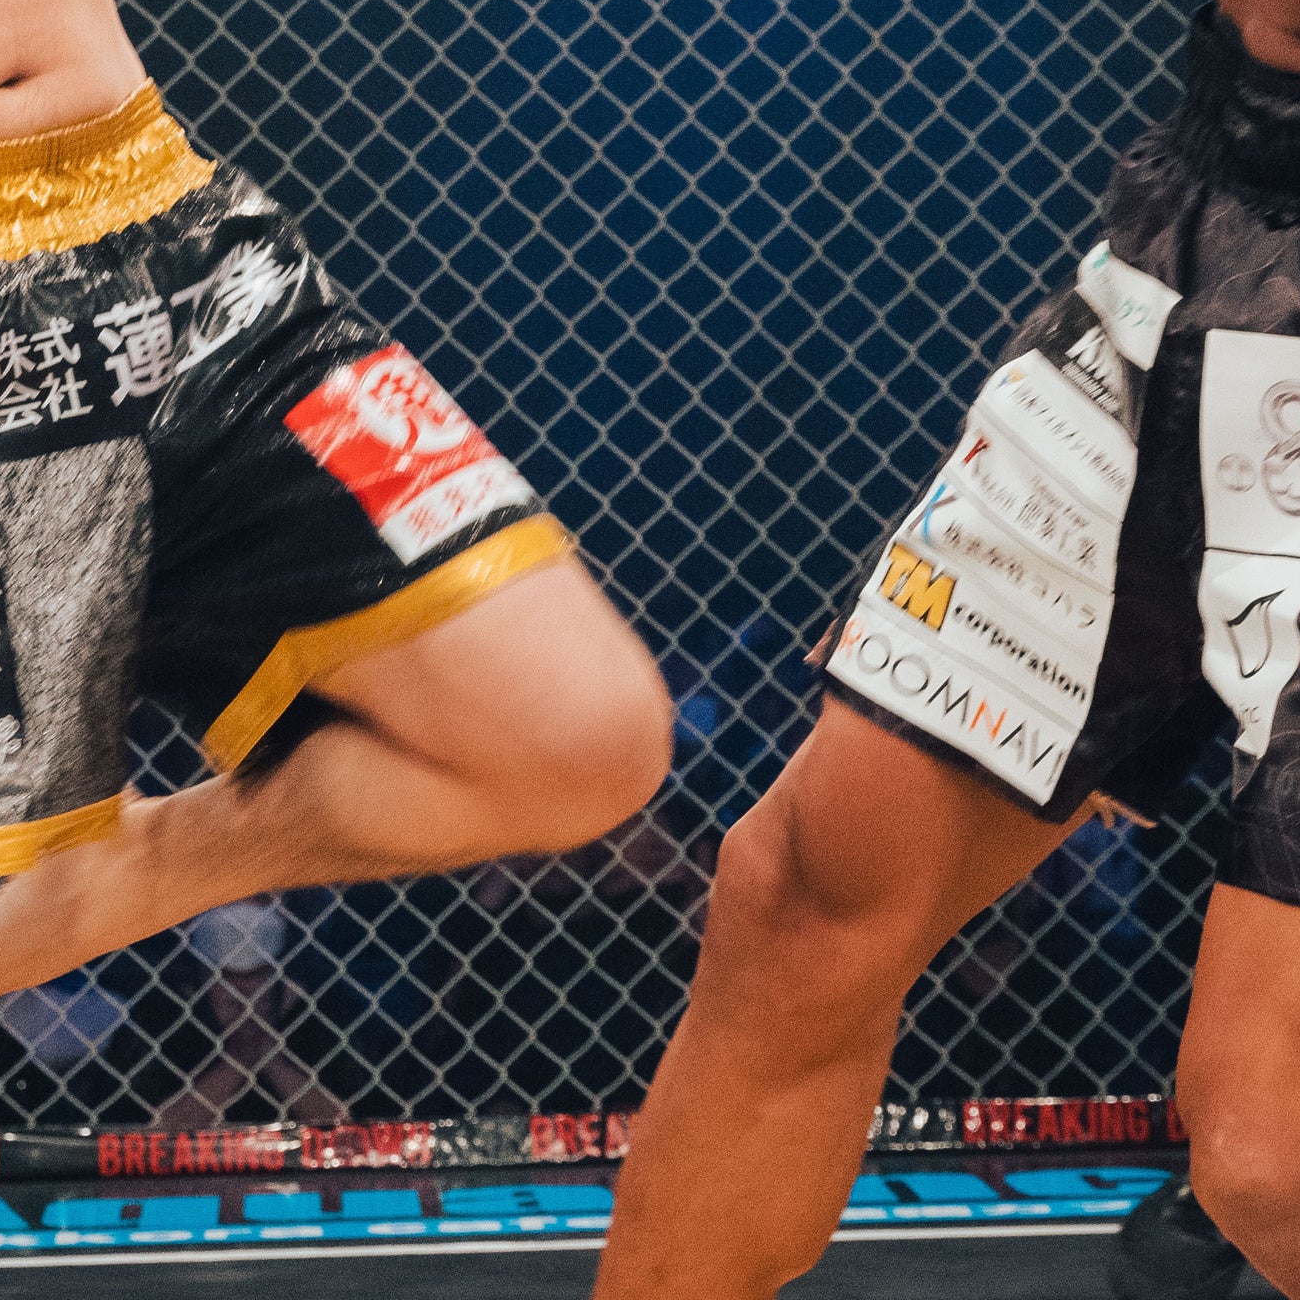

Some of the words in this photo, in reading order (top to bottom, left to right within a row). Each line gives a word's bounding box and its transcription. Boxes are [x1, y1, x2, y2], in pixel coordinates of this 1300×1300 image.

[951, 602, 1088, 705] corporation
[962, 1098, 1151, 1143] BREAKING
[99, 1130, 287, 1178] BREAKING
